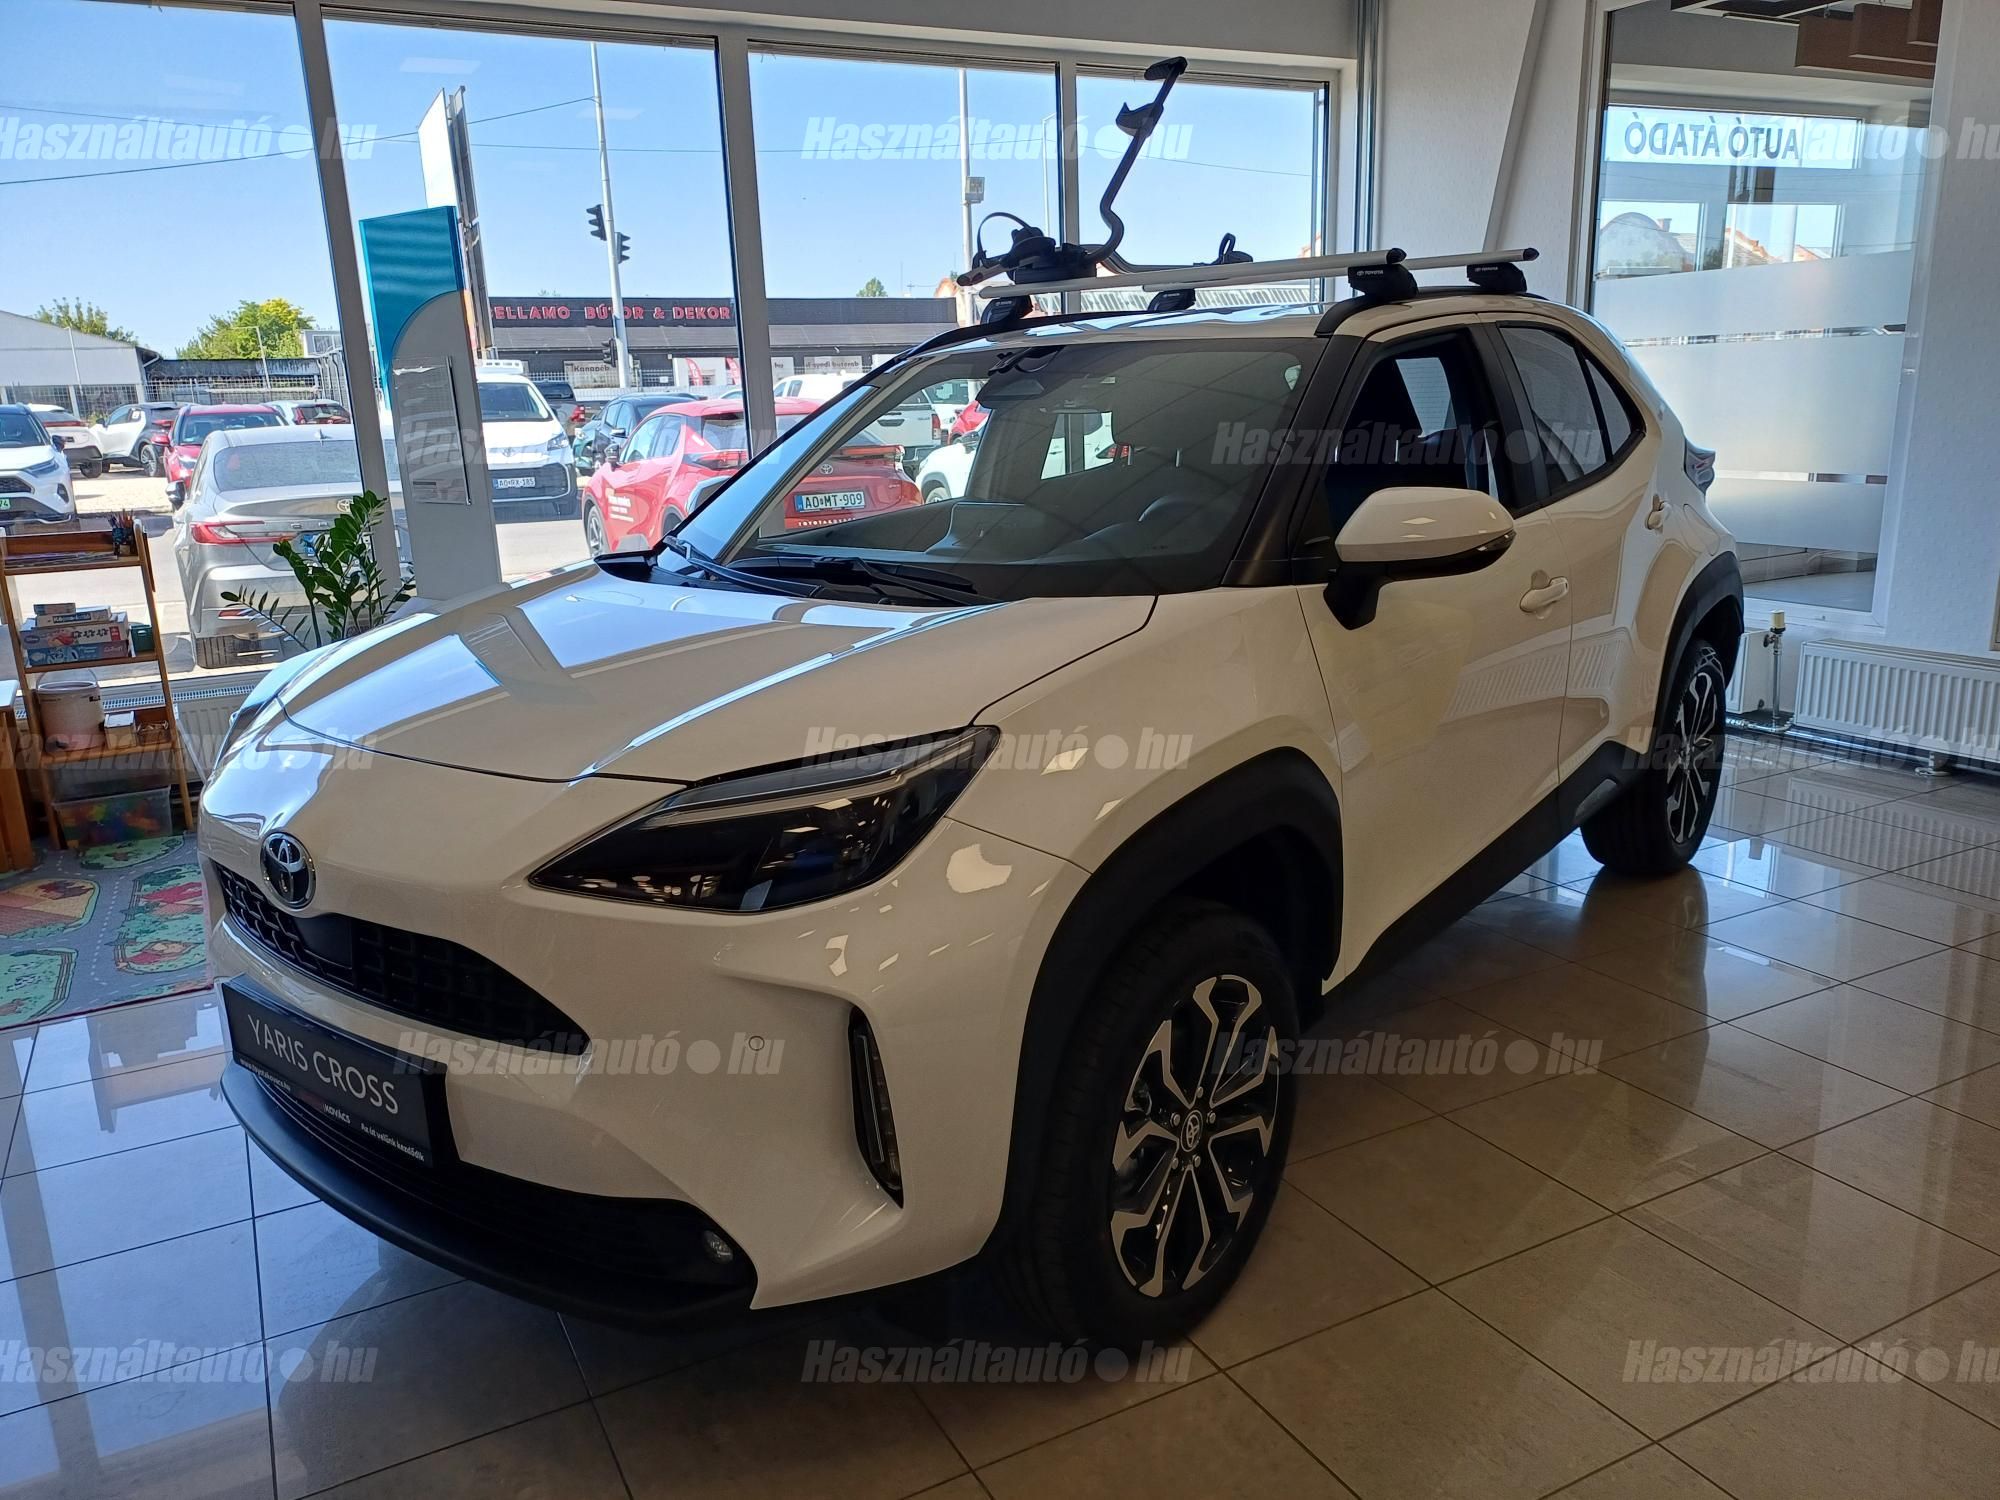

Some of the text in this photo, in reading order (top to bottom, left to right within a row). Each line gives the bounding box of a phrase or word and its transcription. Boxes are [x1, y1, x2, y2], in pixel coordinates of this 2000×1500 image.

[491, 303, 732, 320] ELLAMO BÚOR & DEKOR
[247, 1014, 399, 1114] YARIS CROSS
